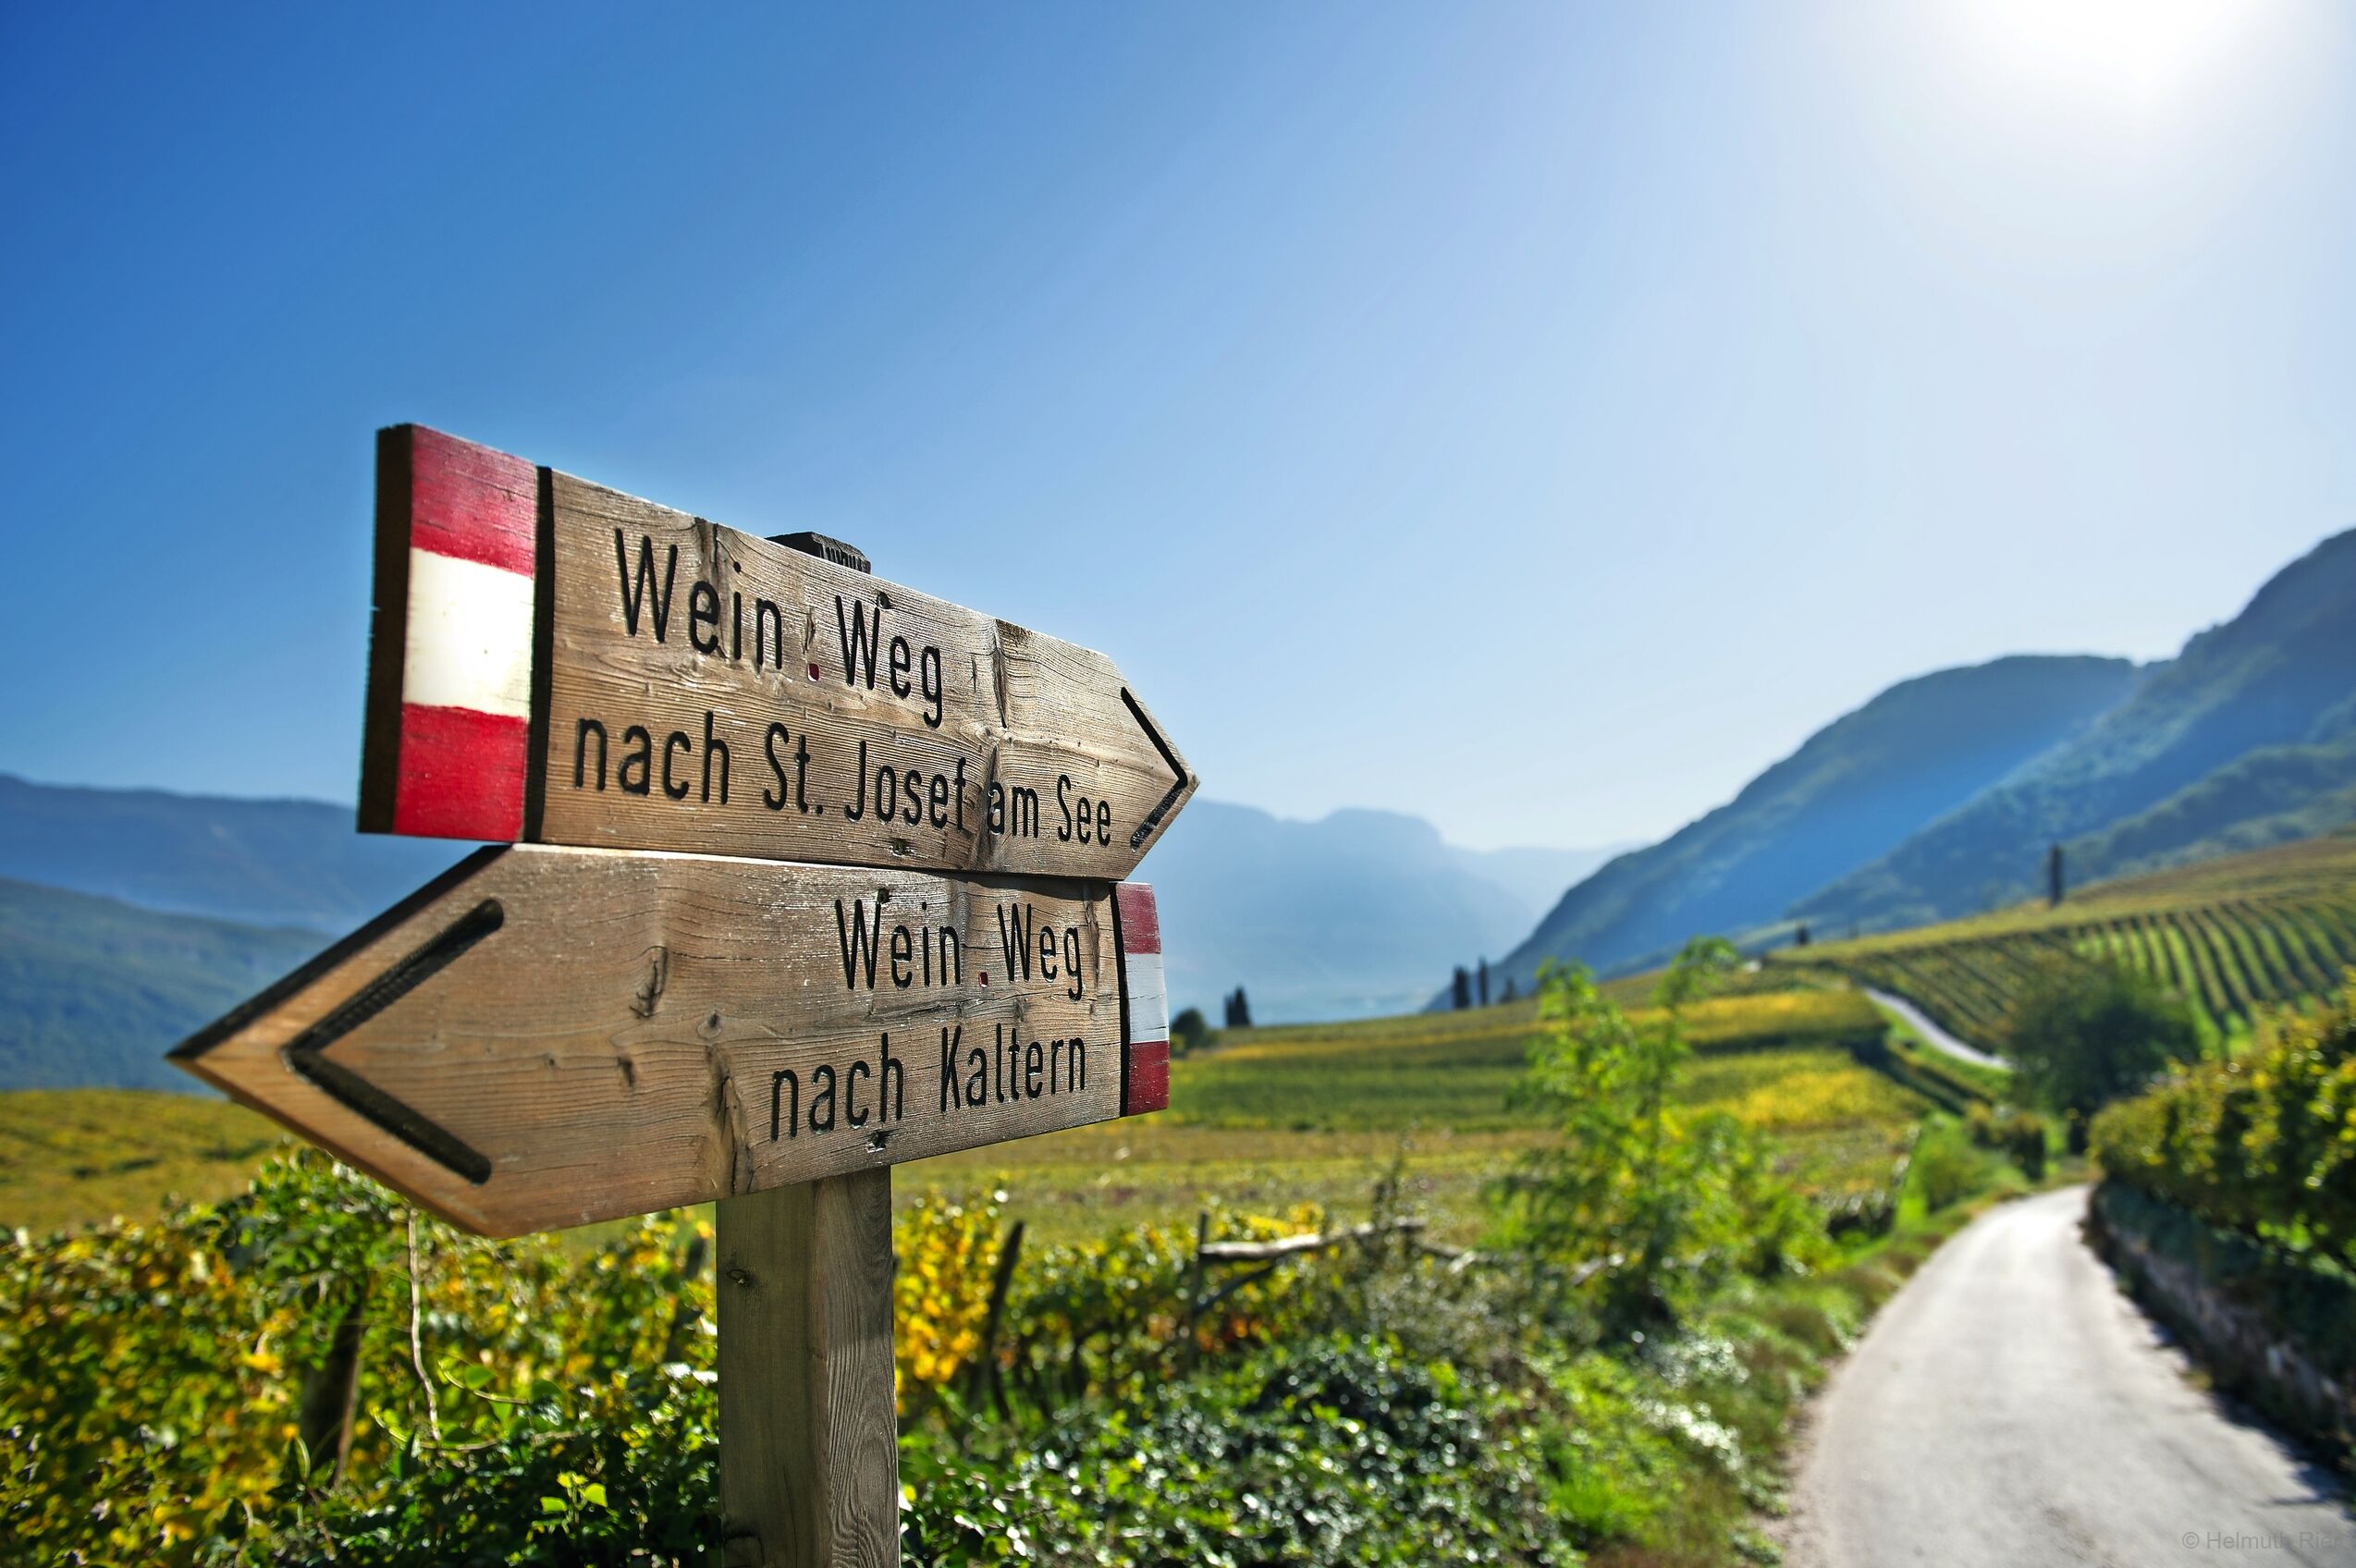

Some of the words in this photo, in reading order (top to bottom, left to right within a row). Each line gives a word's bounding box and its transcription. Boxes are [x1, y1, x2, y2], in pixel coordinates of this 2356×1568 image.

[835, 594, 943, 729] Weg
[573, 711, 730, 806] nach
[763, 721, 824, 815] St.
[844, 741, 968, 833] Josef
[988, 779, 1039, 837] am
[1056, 775, 1111, 847] See
[997, 902, 1085, 1001] Weg
[770, 1032, 904, 1143] nach
[940, 1023, 1086, 1112] Kaltern
